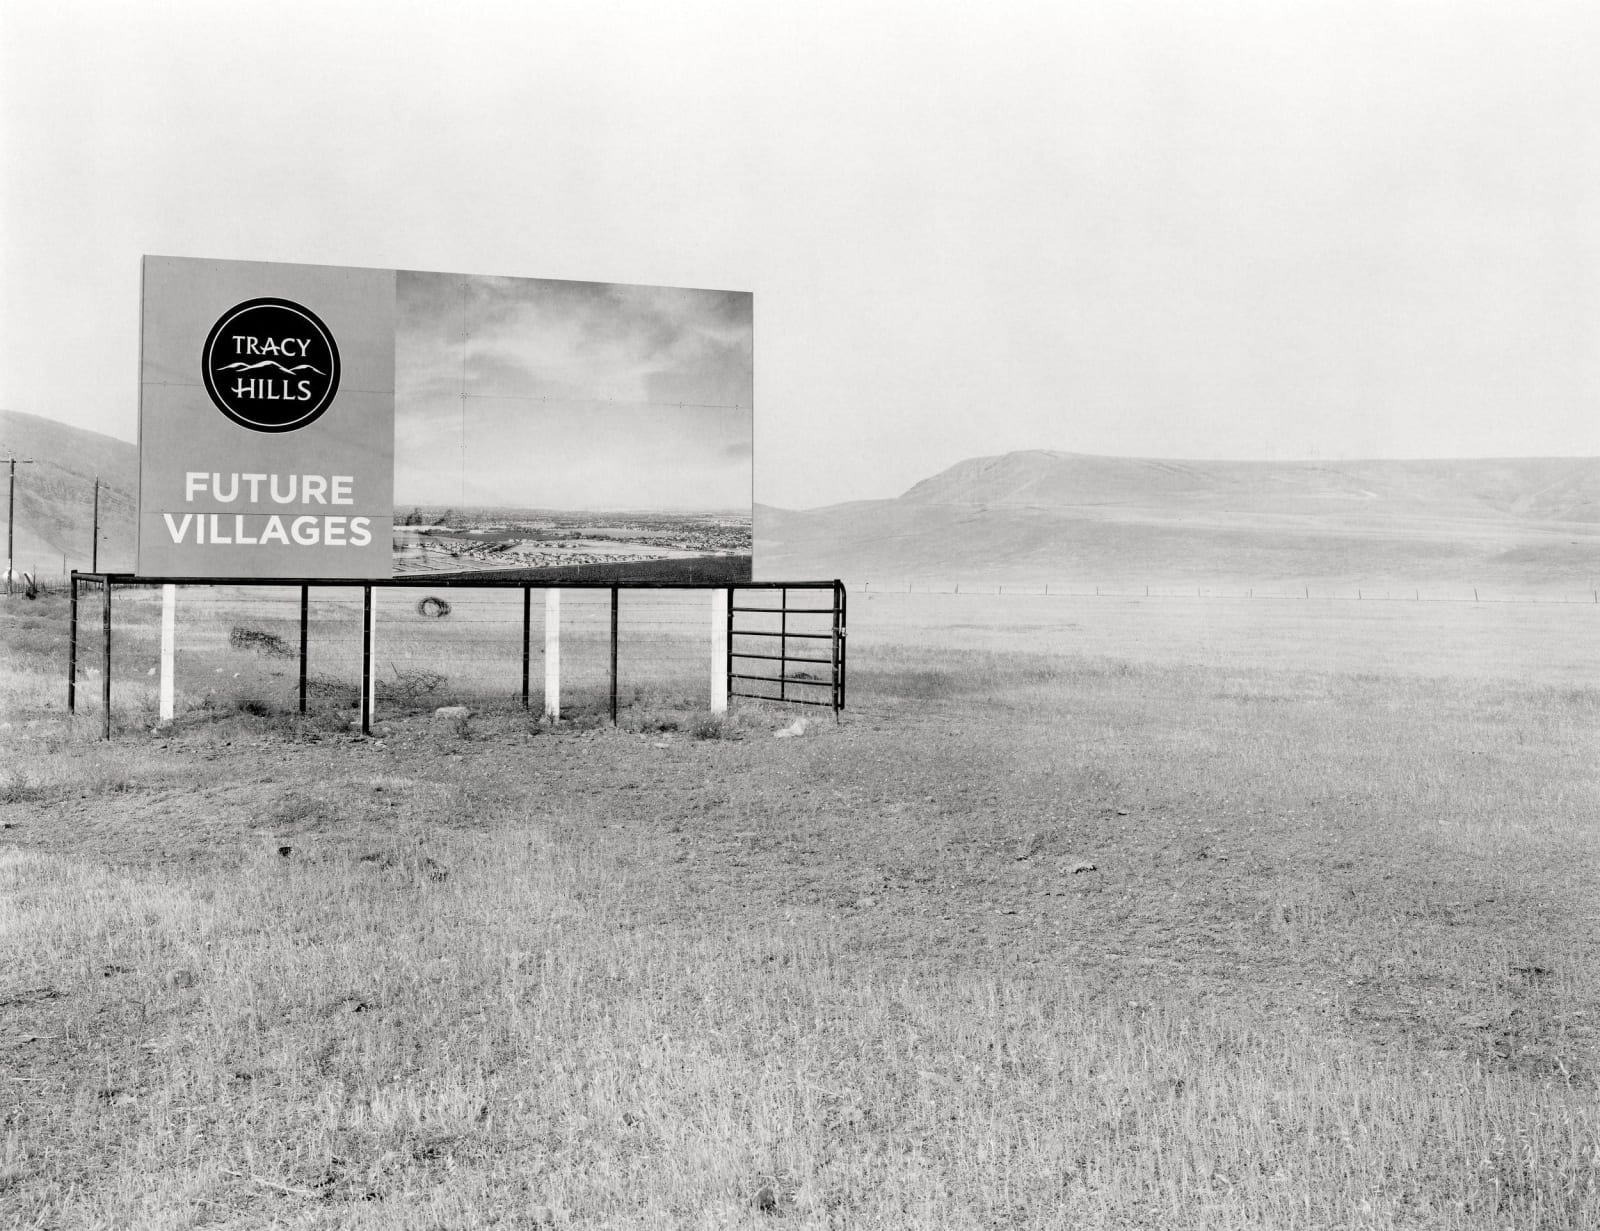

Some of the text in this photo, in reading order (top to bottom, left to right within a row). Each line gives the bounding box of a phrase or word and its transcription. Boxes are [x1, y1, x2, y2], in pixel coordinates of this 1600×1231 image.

[232, 335, 311, 357] TRACY
[231, 377, 312, 401] HILLS
[185, 472, 354, 505] FUTURE
[163, 513, 372, 547] VILLAGES
